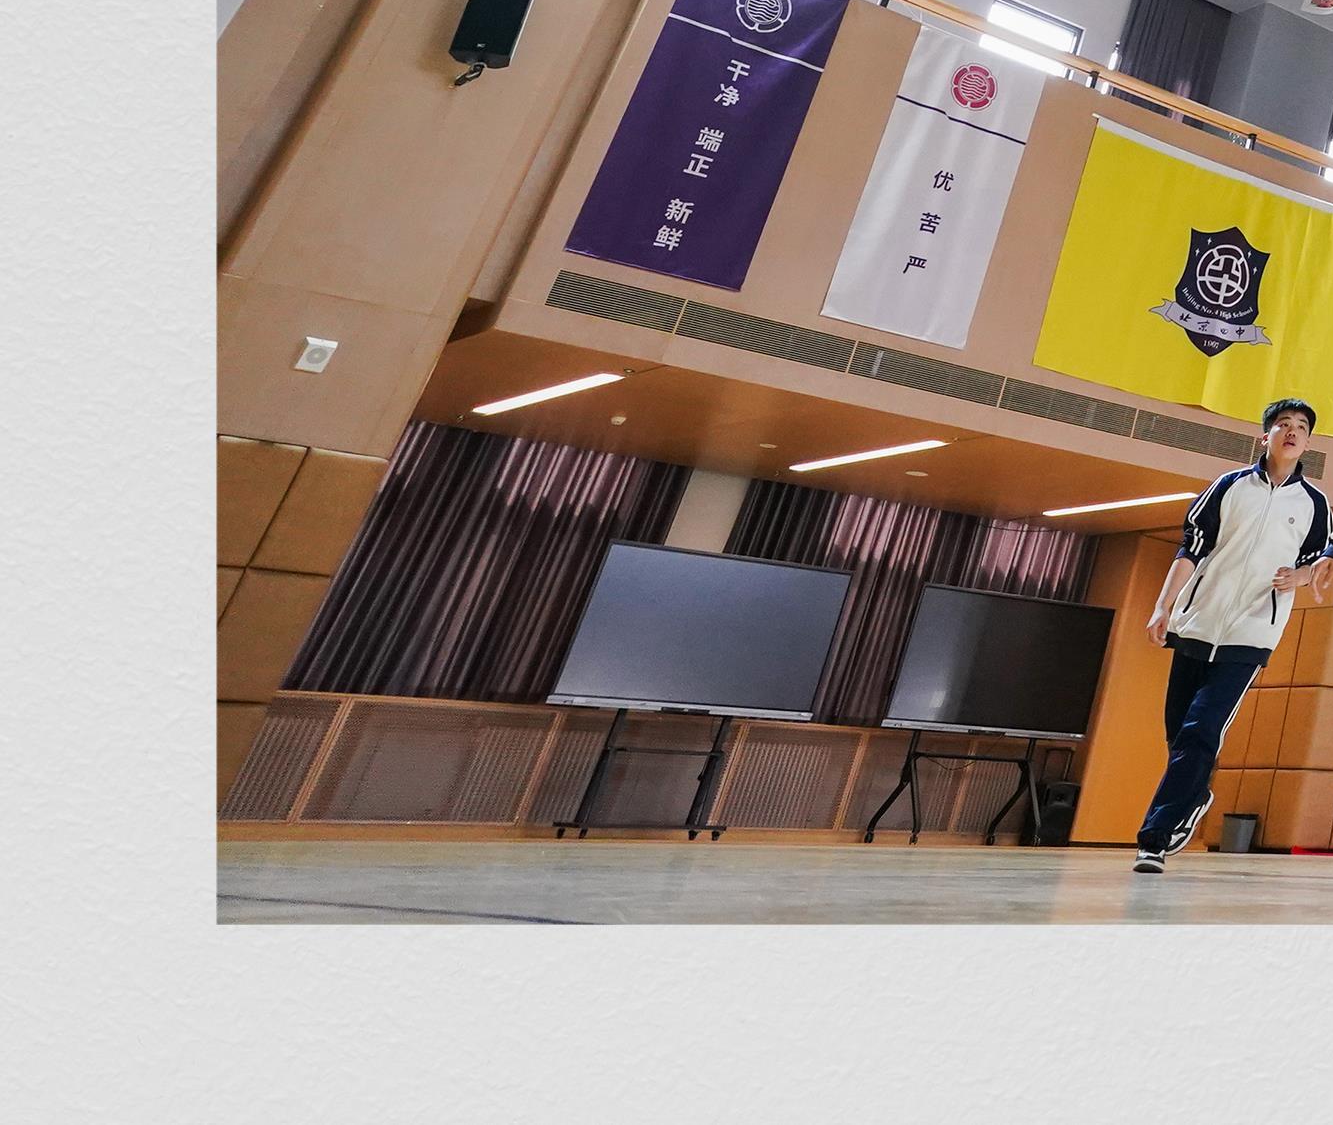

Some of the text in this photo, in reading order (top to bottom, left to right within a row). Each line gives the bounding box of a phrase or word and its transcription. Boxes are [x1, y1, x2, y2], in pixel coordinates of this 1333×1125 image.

[652, 58, 751, 253] 干净 端正 新鲜
[902, 169, 955, 276] 优苦严
